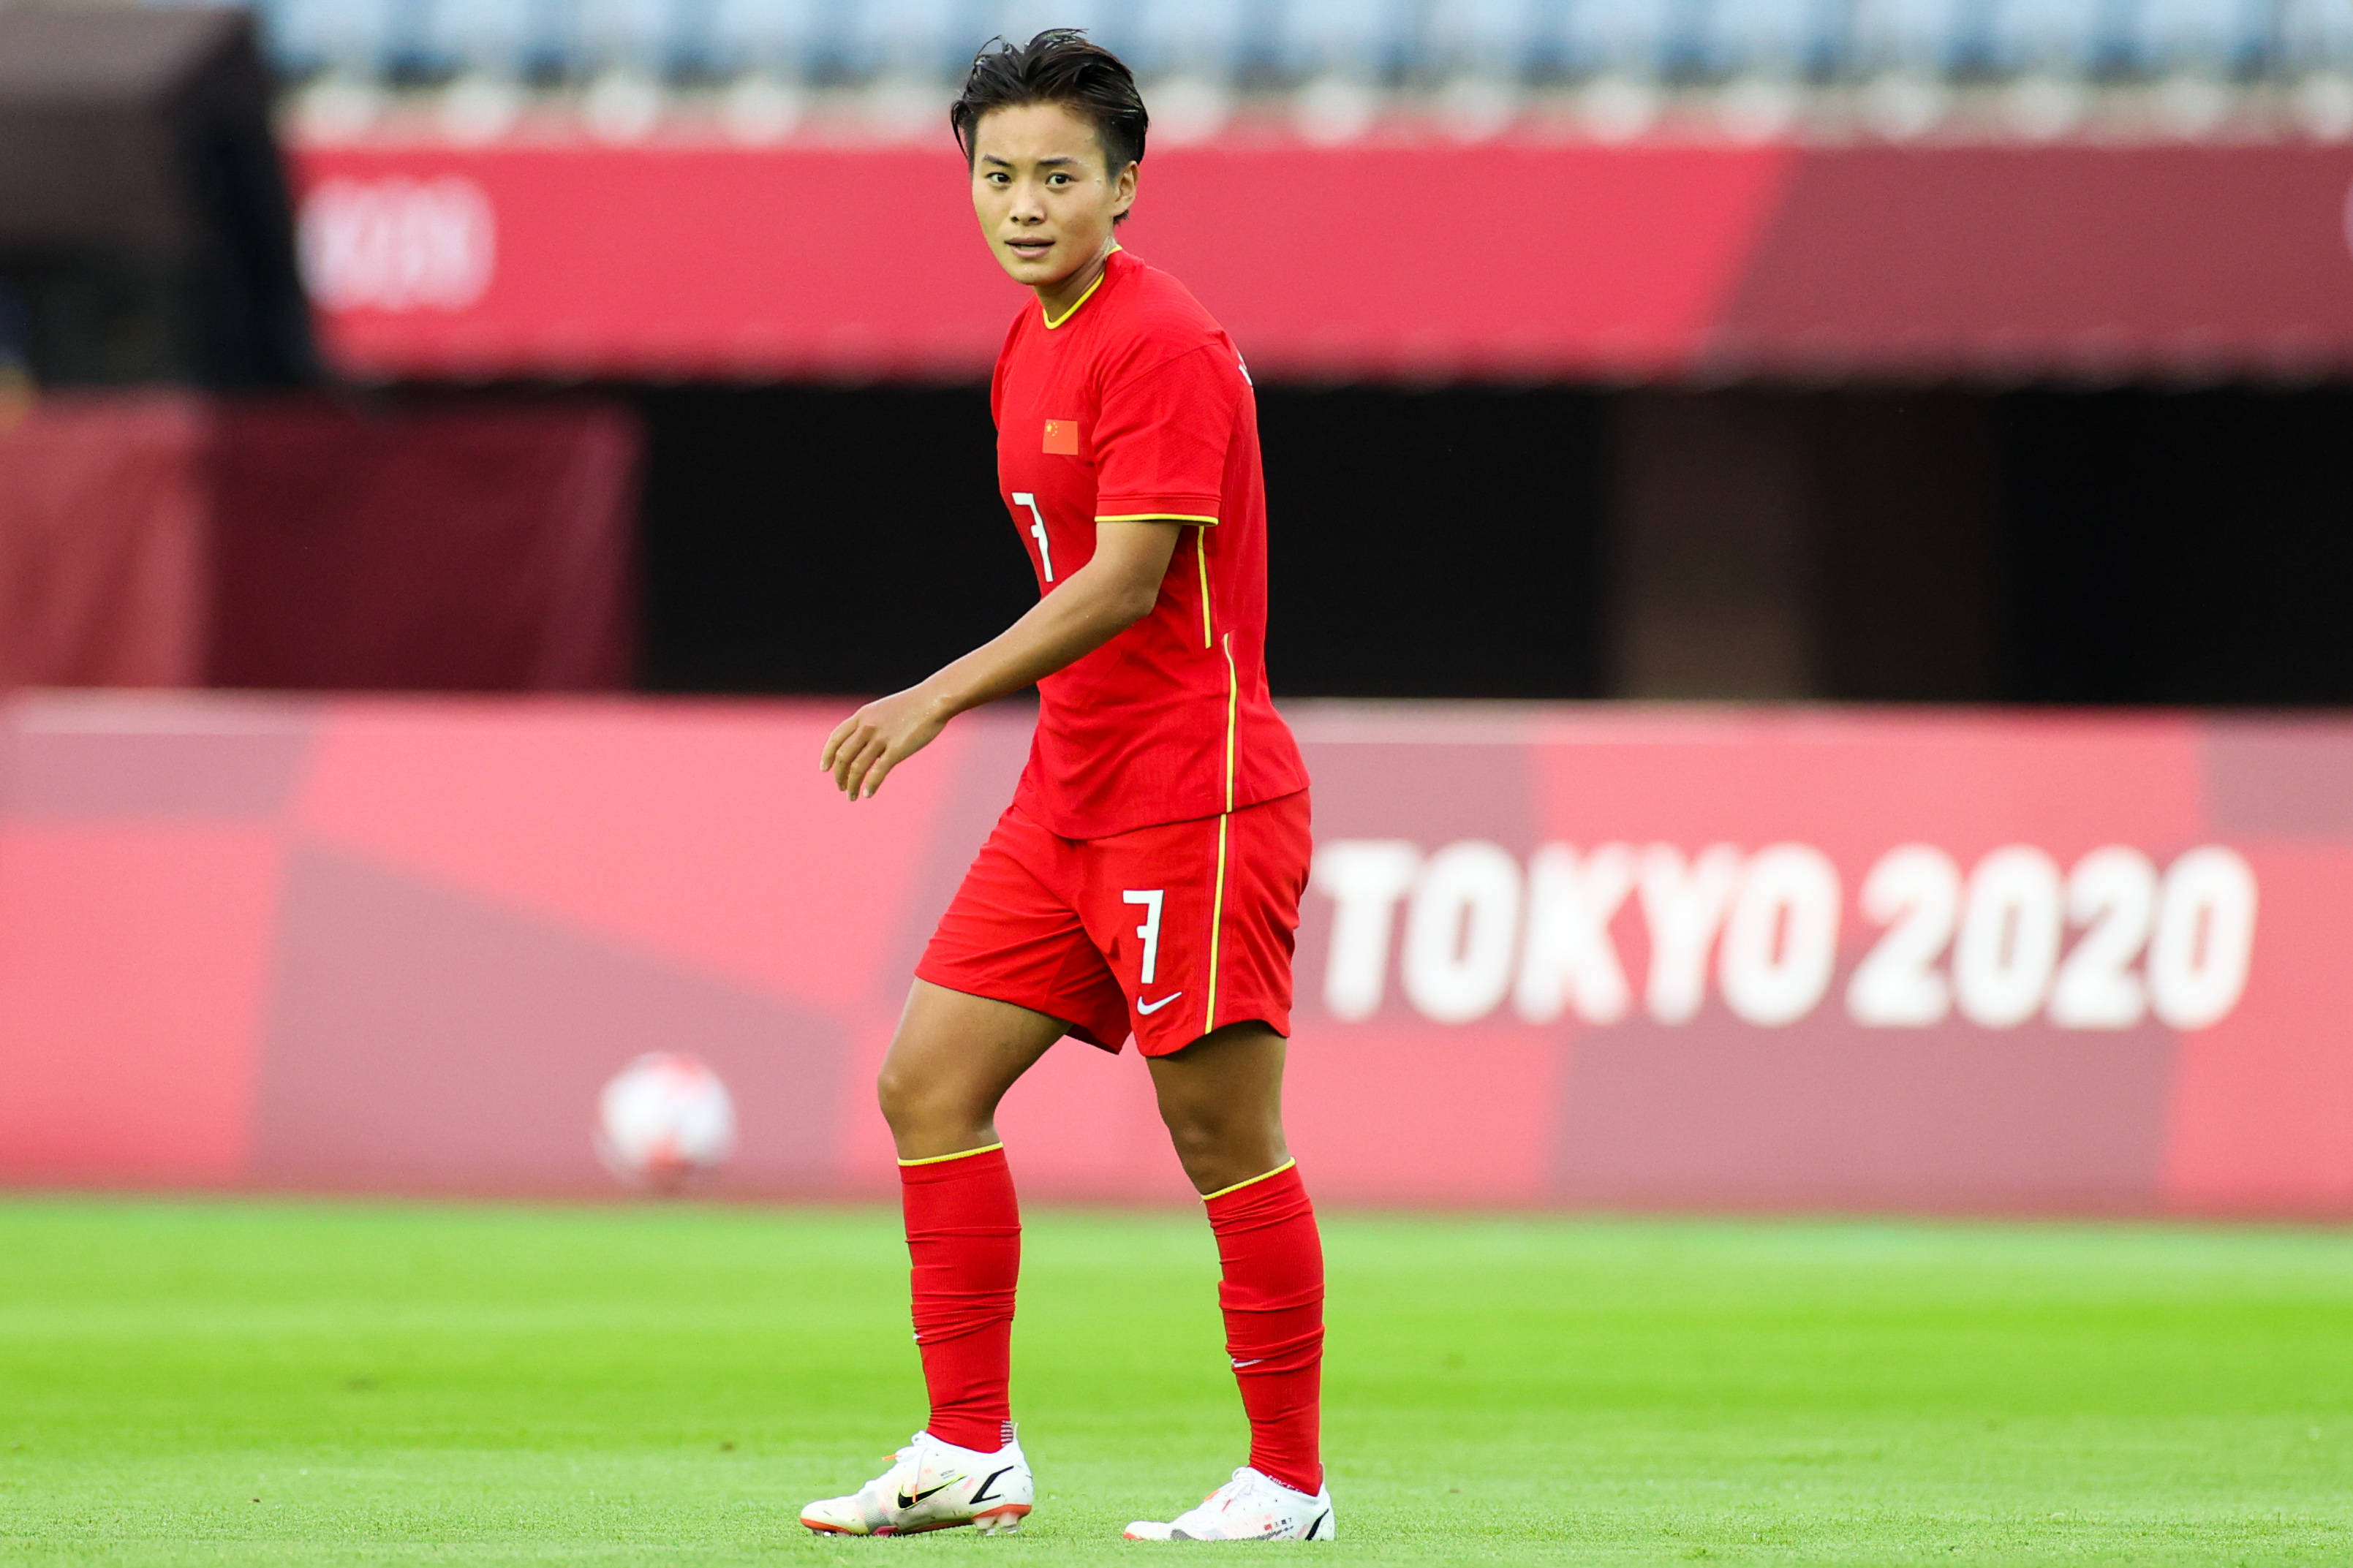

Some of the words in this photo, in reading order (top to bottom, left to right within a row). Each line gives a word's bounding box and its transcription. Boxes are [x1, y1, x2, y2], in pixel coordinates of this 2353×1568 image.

[1011, 492, 1054, 583] 7
[1122, 889, 1164, 984] 7
[1317, 839, 1841, 1026] TOKYO
[1847, 844, 2258, 1029] 2020
